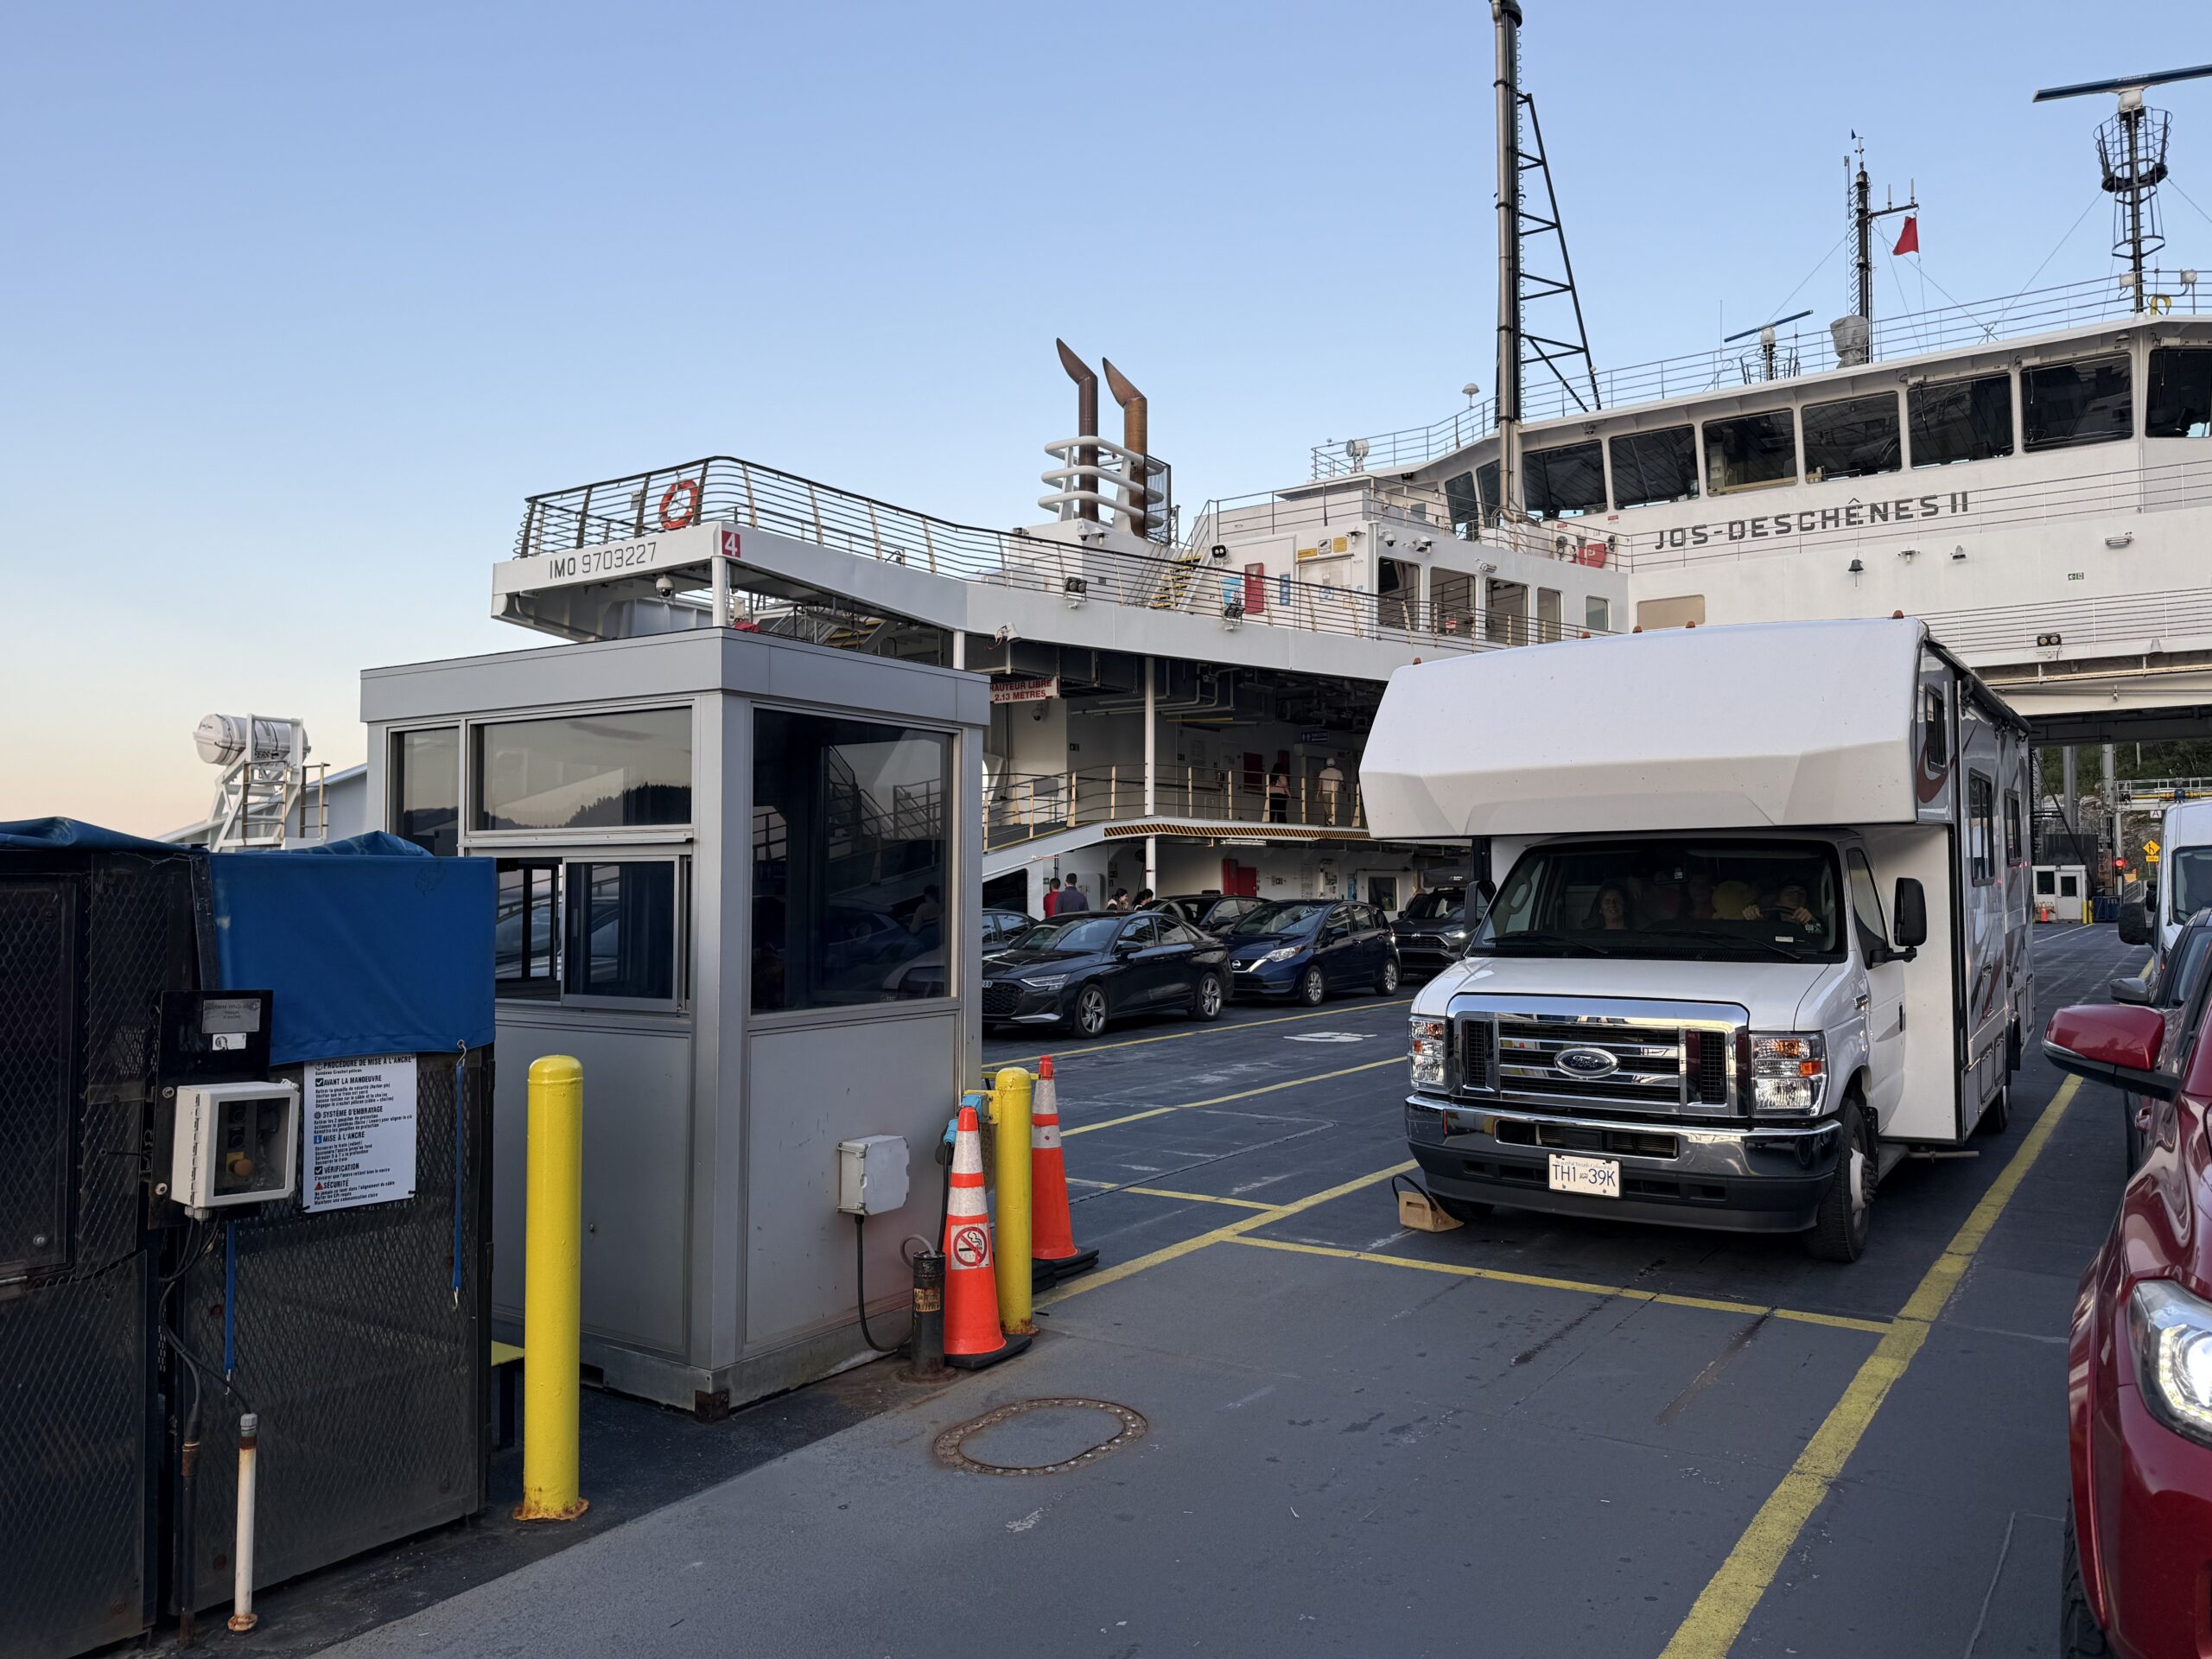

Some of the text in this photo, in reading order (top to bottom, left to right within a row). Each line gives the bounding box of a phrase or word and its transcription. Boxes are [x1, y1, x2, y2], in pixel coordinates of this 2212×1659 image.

[1654, 491, 1967, 550] JOS-DESCHÊNES II
[724, 532, 738, 556] 4
[550, 542, 657, 579] IMO 9703227
[990, 678, 1052, 692] HAUTEUR LIBRE
[995, 693, 1010, 702] 2.13
[1570, 1055, 1598, 1067] Ford
[324, 1077, 340, 1086] AVANT
[350, 1075, 382, 1084] MANOEUVRE
[348, 1106, 383, 1116] D'EMBRAYAGE
[343, 1131, 365, 1140] L'ANCRE
[324, 1163, 359, 1173] VÉRIFICATION
[1589, 1168, 1615, 1186] 39K
[324, 1179, 349, 1189] SÉCURITÉ
